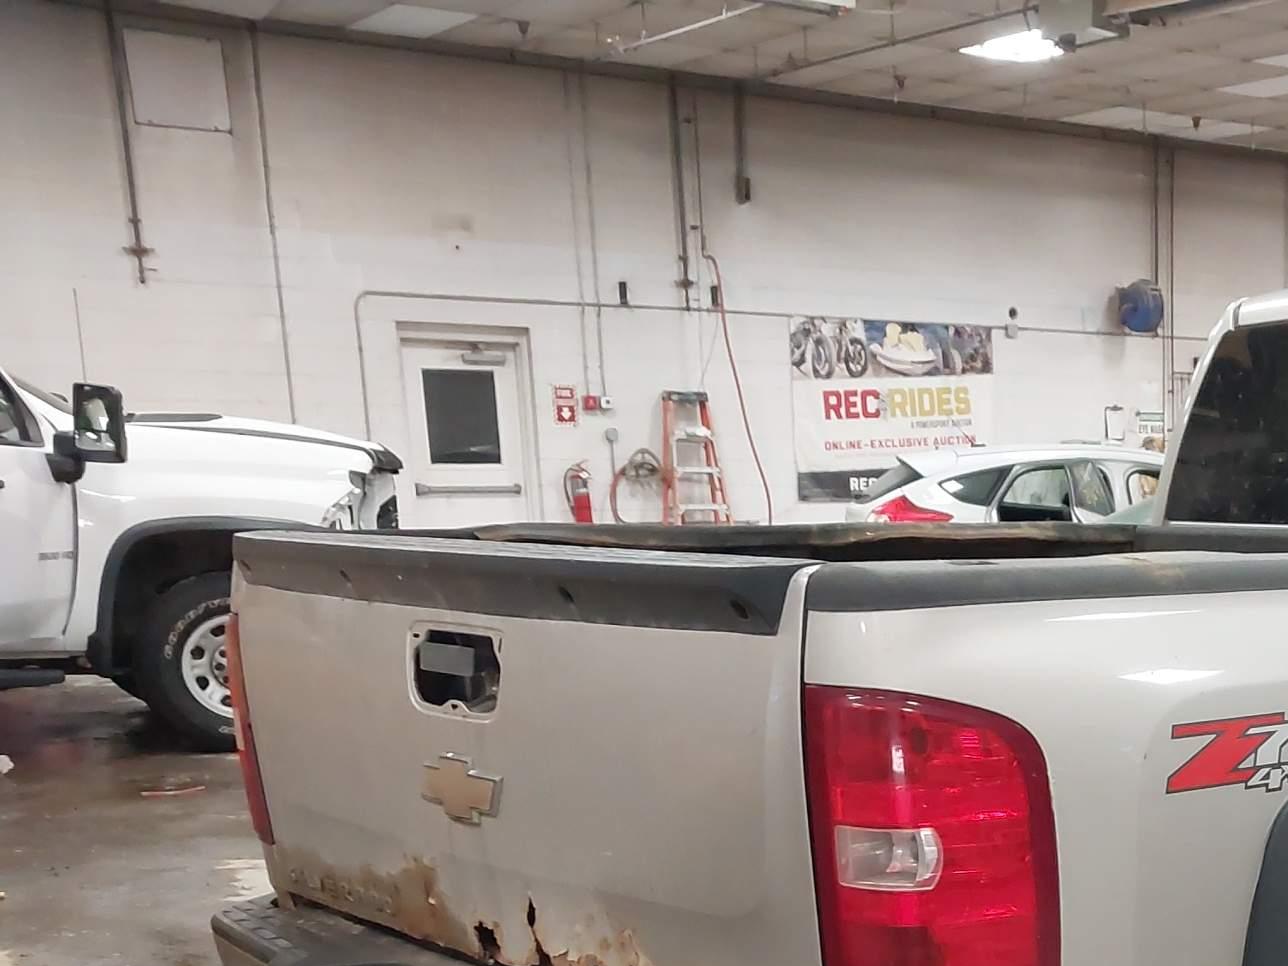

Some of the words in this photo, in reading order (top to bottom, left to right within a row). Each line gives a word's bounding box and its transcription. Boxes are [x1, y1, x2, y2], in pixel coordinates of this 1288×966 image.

[822, 389, 881, 420] REC
[887, 386, 972, 418] RIDES
[824, 436, 929, 452] ONLINE-EXCLUSIVE
